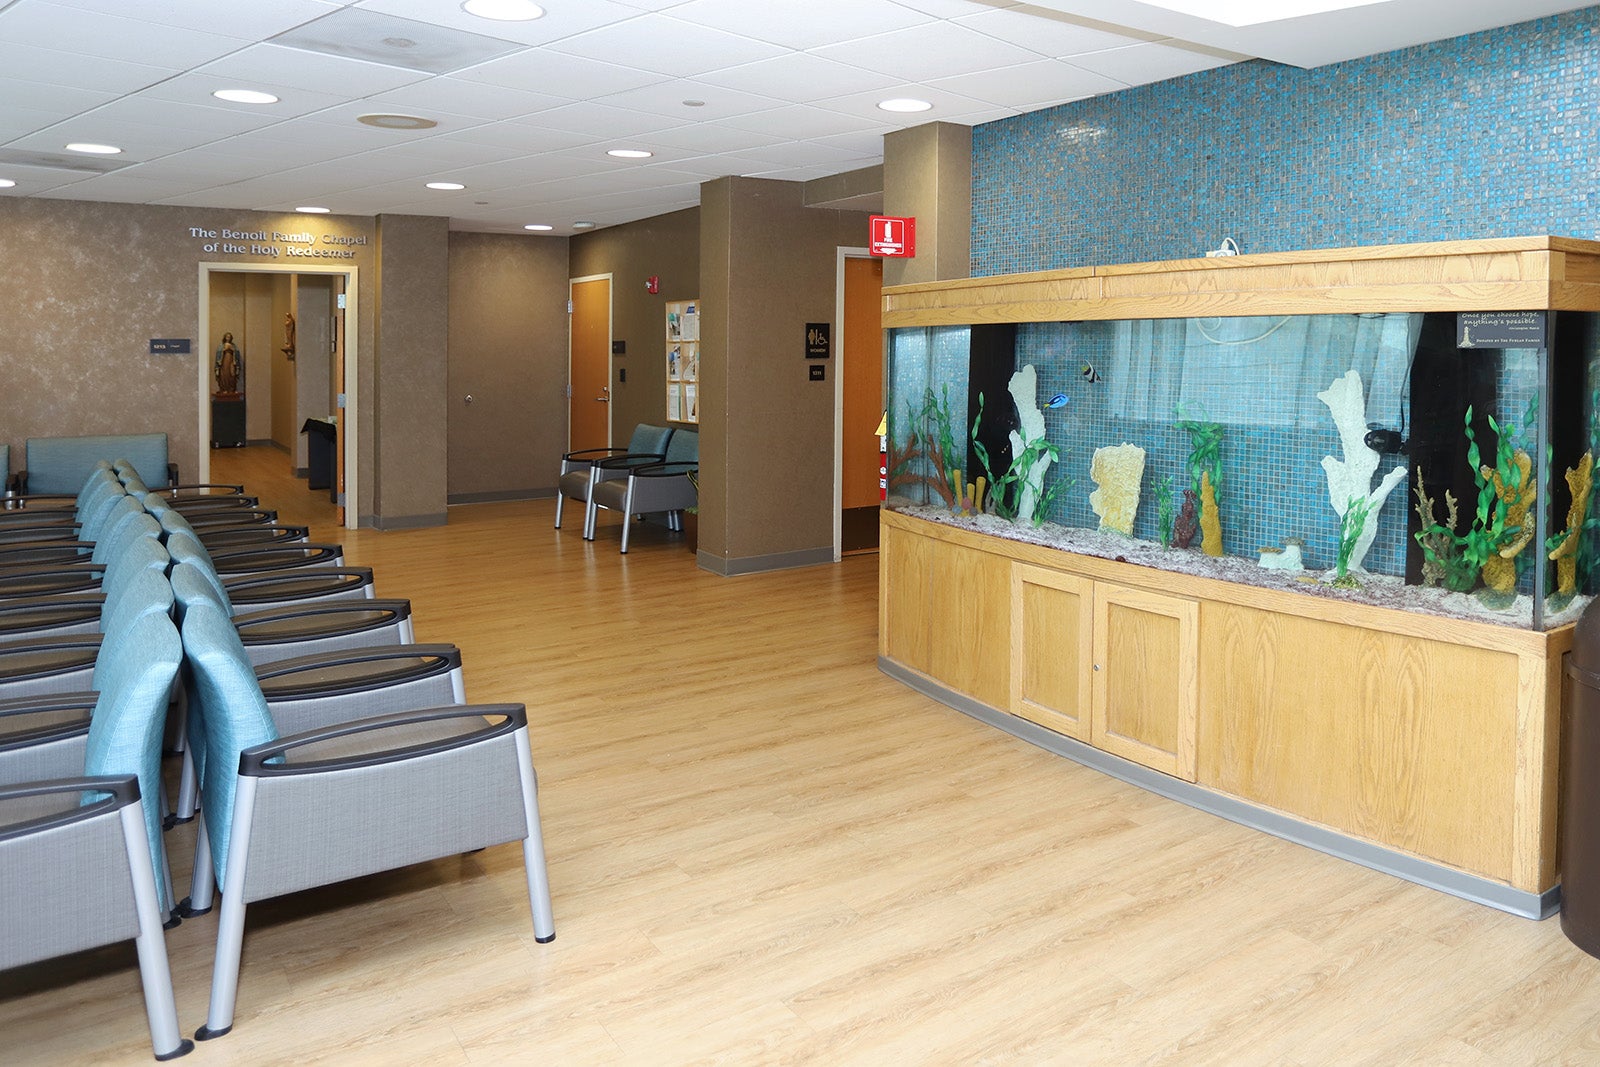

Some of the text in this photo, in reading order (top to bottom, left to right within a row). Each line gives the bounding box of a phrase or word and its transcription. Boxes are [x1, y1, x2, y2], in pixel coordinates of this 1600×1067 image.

[189, 227, 367, 247] The Benoit Family Chapel
[203, 242, 355, 258] of the Holy Redeemer
